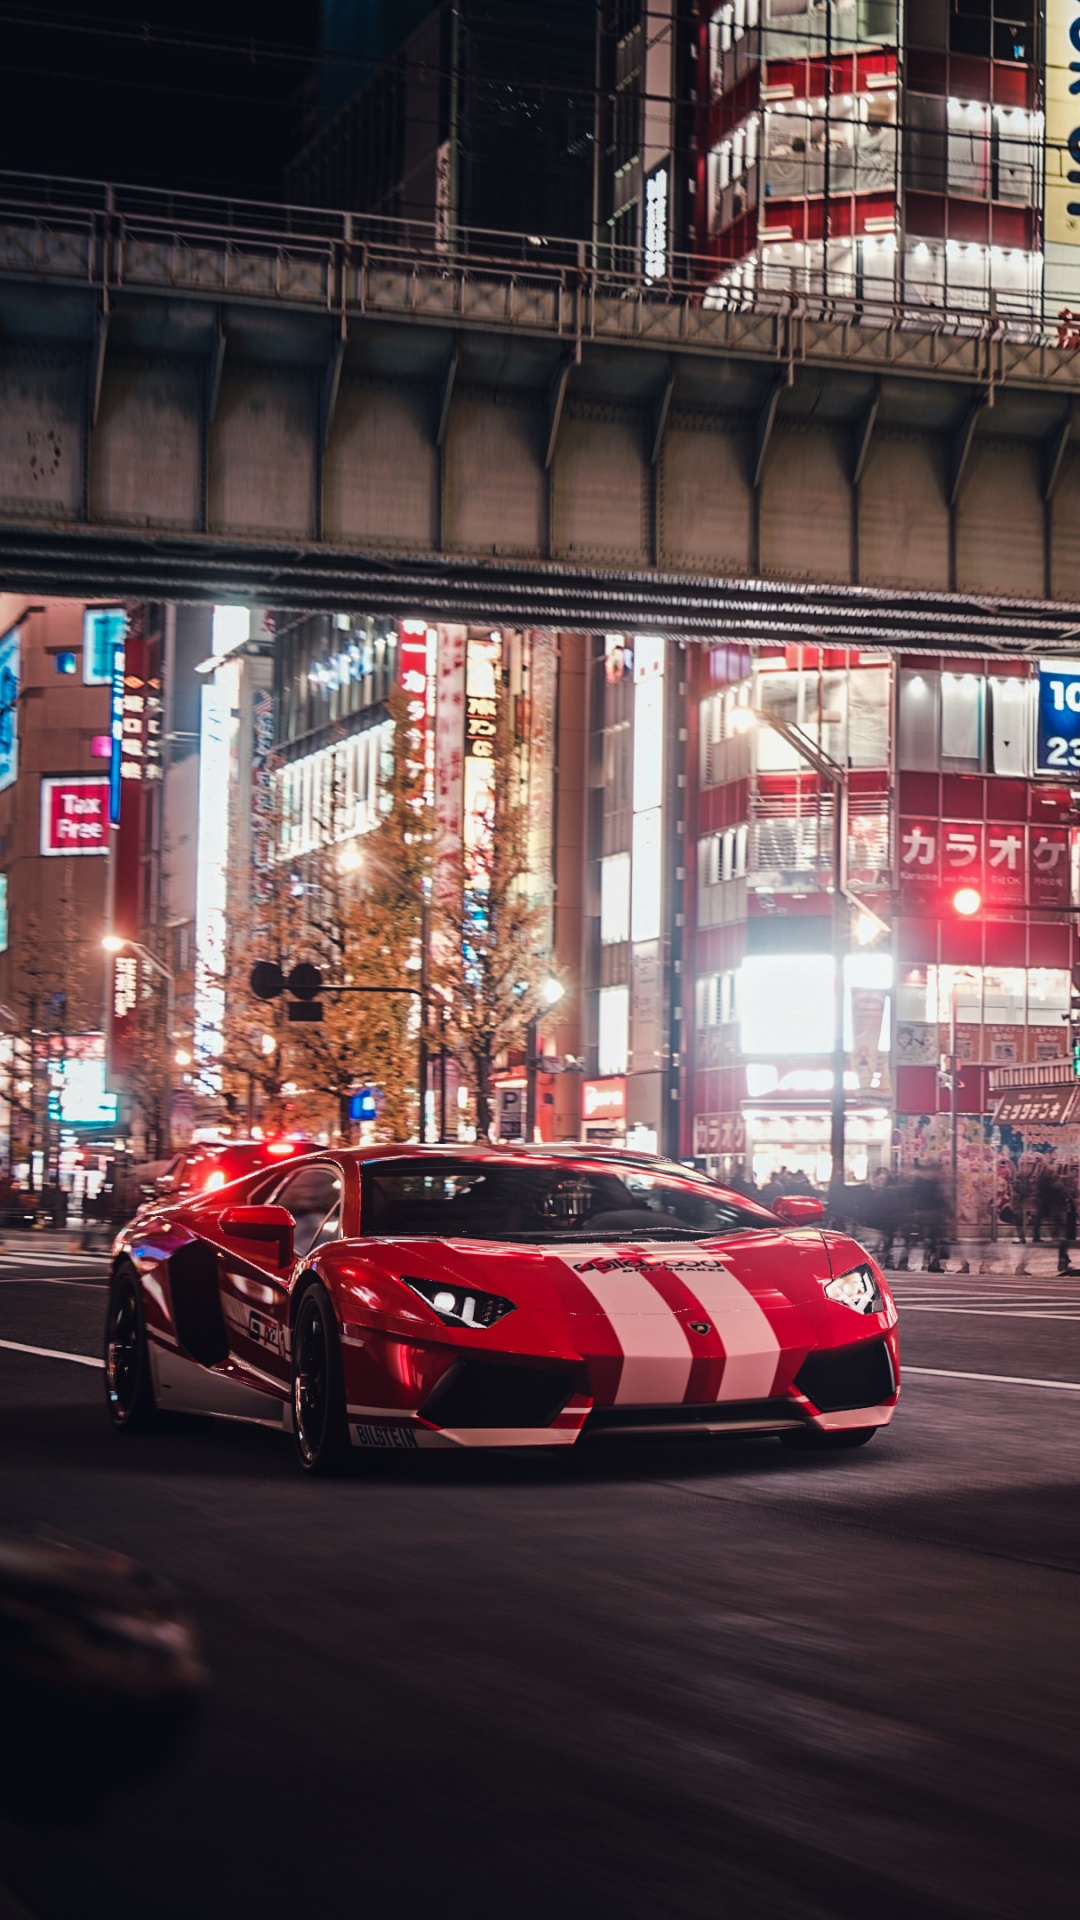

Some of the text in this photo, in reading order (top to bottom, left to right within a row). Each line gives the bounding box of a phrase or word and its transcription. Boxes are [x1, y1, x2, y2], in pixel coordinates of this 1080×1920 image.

[61, 794, 102, 815] Tax
[57, 819, 103, 839] Free
[902, 829, 1066, 870] カラオケ
[503, 1092, 518, 1110] P
[356, 1425, 419, 1448] BILSTEIN
